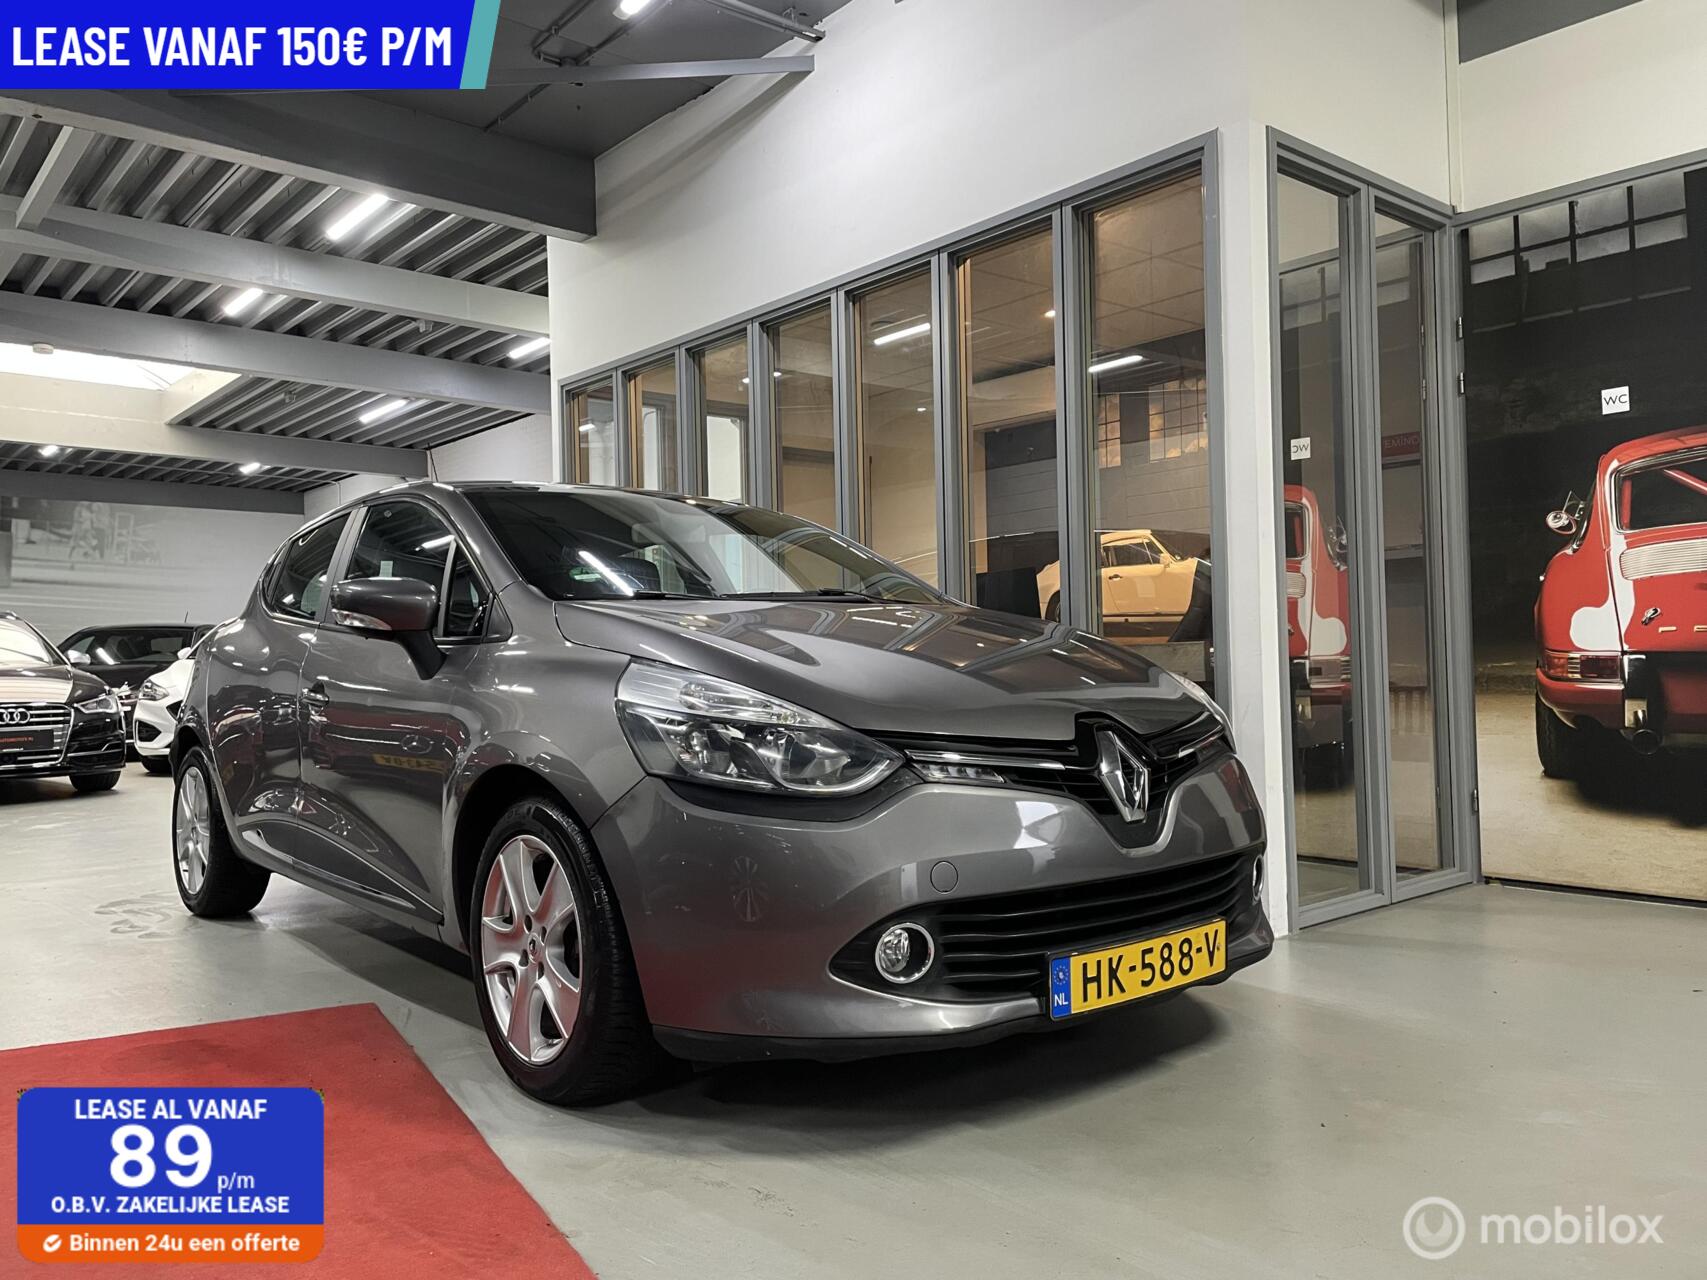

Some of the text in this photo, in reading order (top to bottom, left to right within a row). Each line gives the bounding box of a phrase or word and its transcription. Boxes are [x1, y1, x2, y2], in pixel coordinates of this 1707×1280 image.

[1603, 393, 1628, 406] WC
[1082, 929, 1219, 1003] HK-588-V
[1054, 993, 1069, 1007] NL
